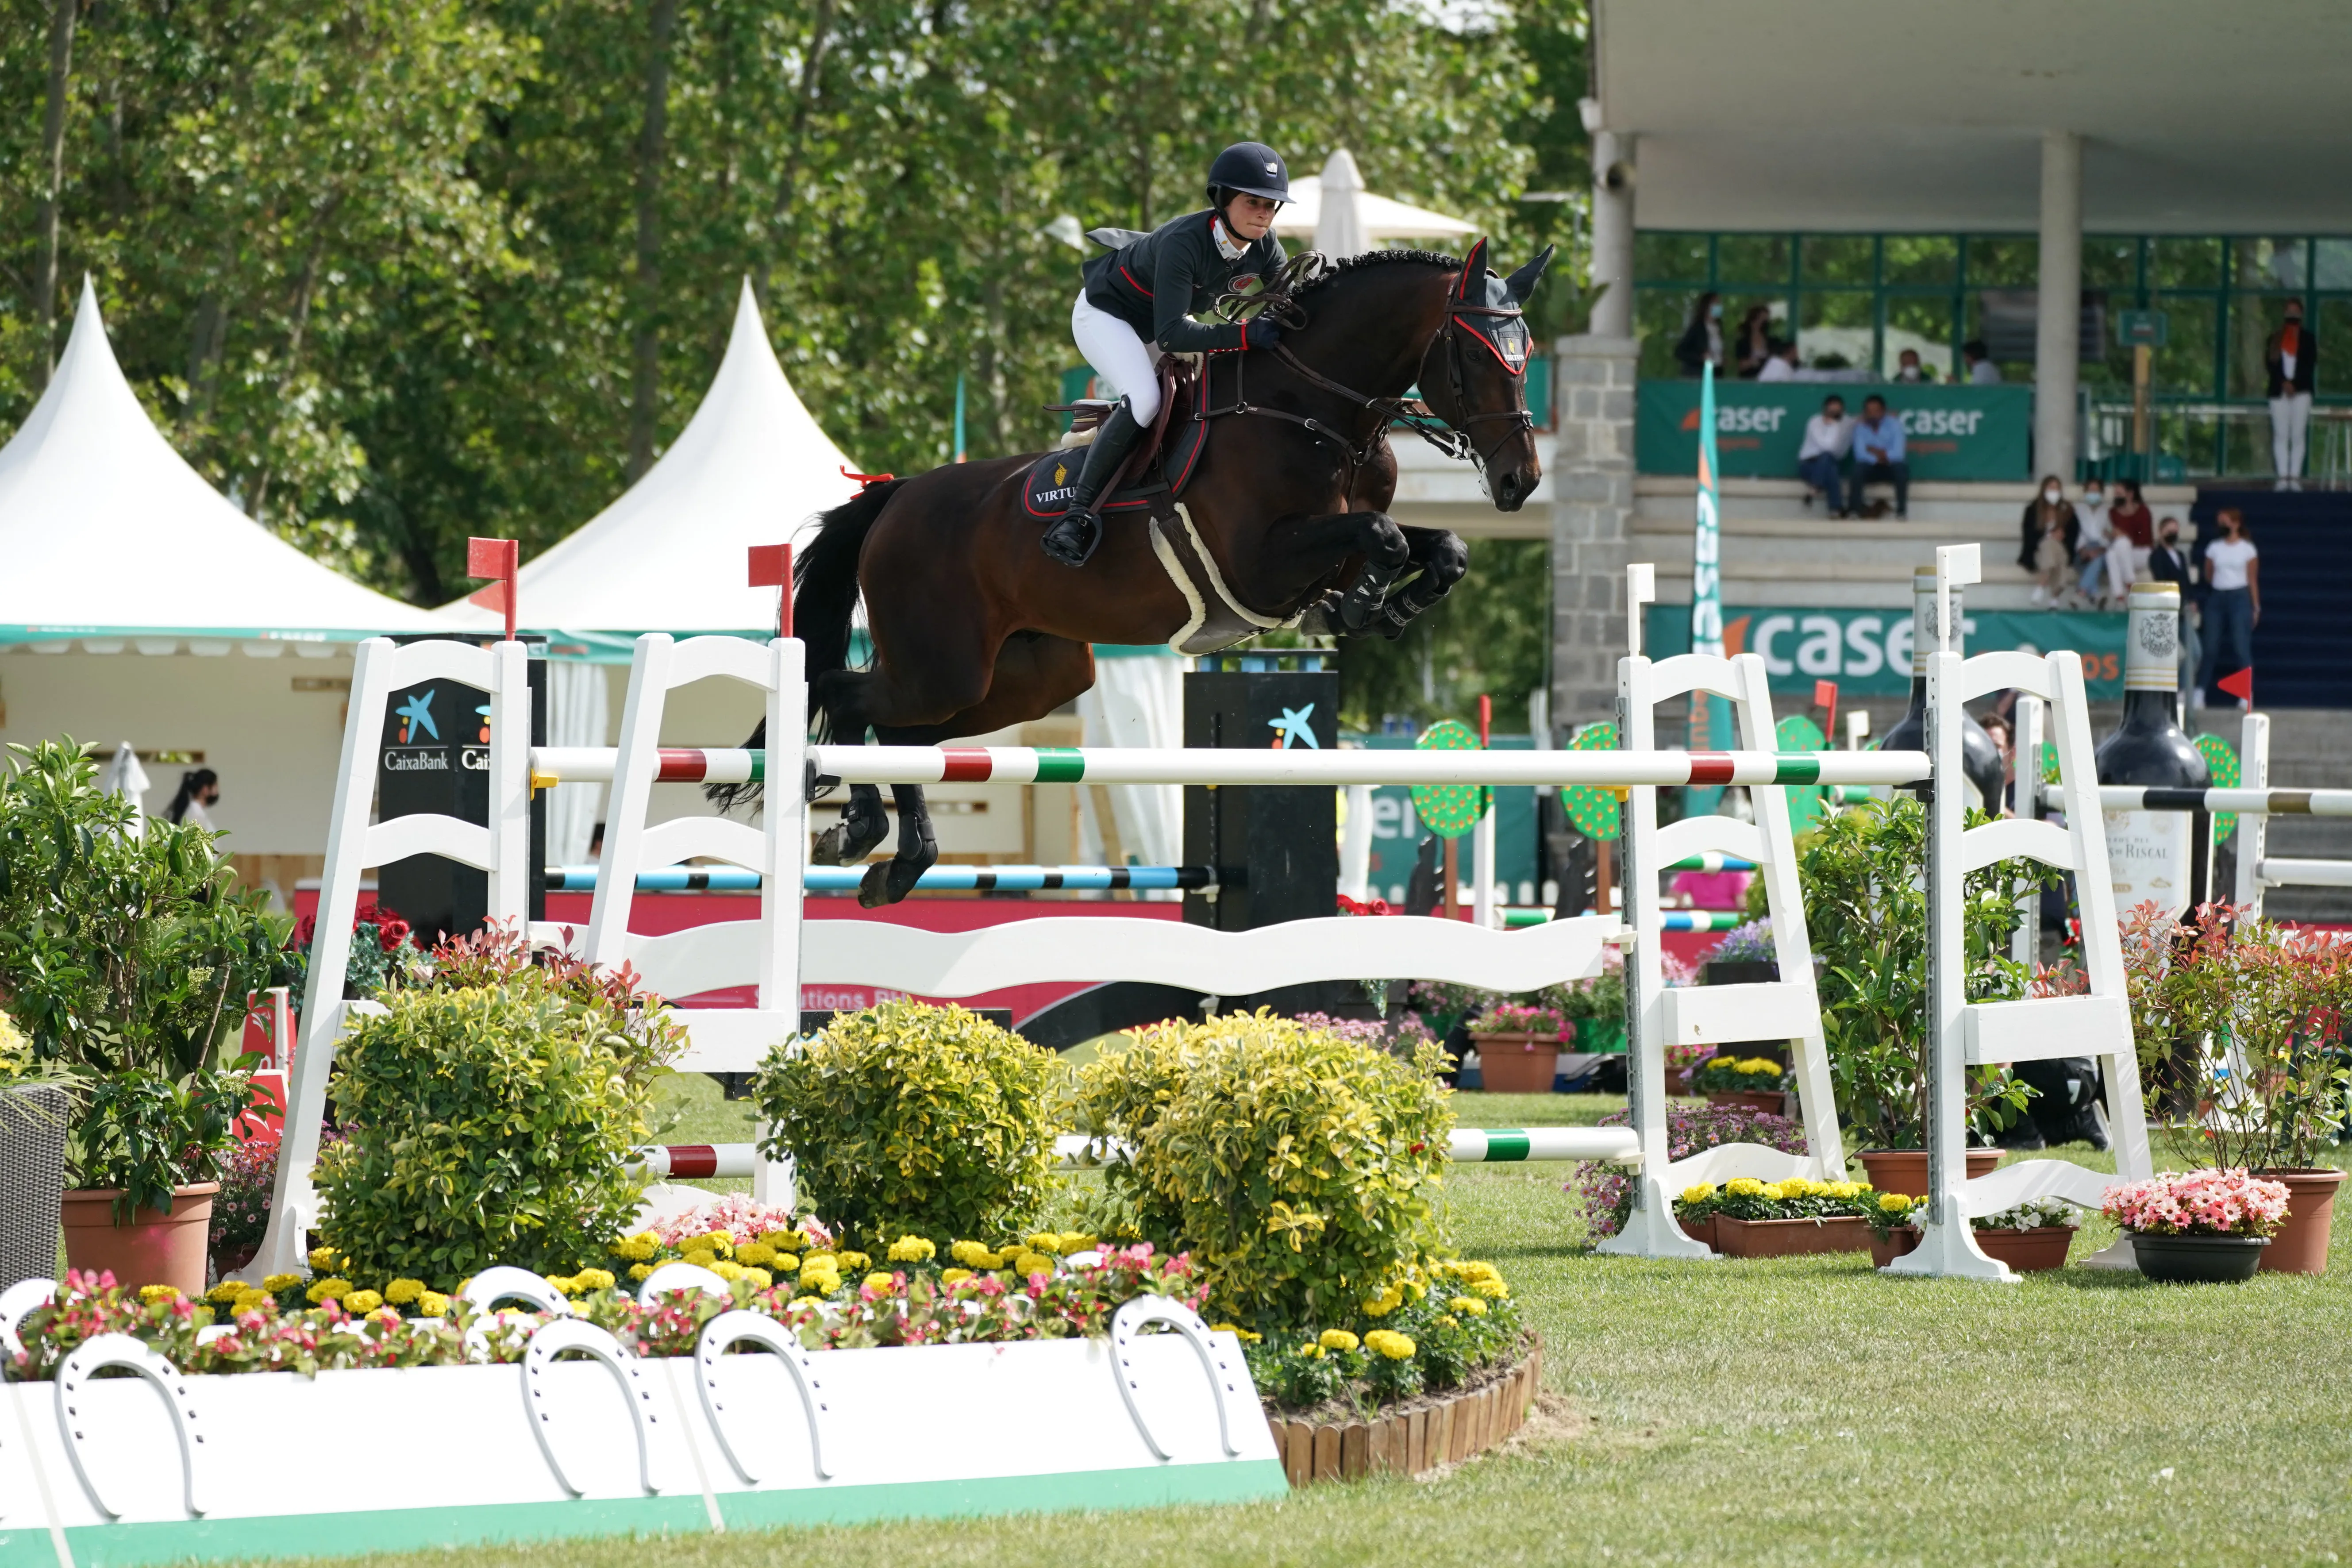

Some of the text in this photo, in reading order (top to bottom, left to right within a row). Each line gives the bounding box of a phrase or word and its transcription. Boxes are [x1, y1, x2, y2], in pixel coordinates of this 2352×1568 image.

[1712, 405, 1787, 432] aser
[1899, 408, 1983, 436] caser
[1035, 487, 1075, 503] VIRTU
[1753, 615, 1976, 676] case
[385, 750, 449, 771] CaixaBank
[2126, 844, 2168, 859] RISCAL
